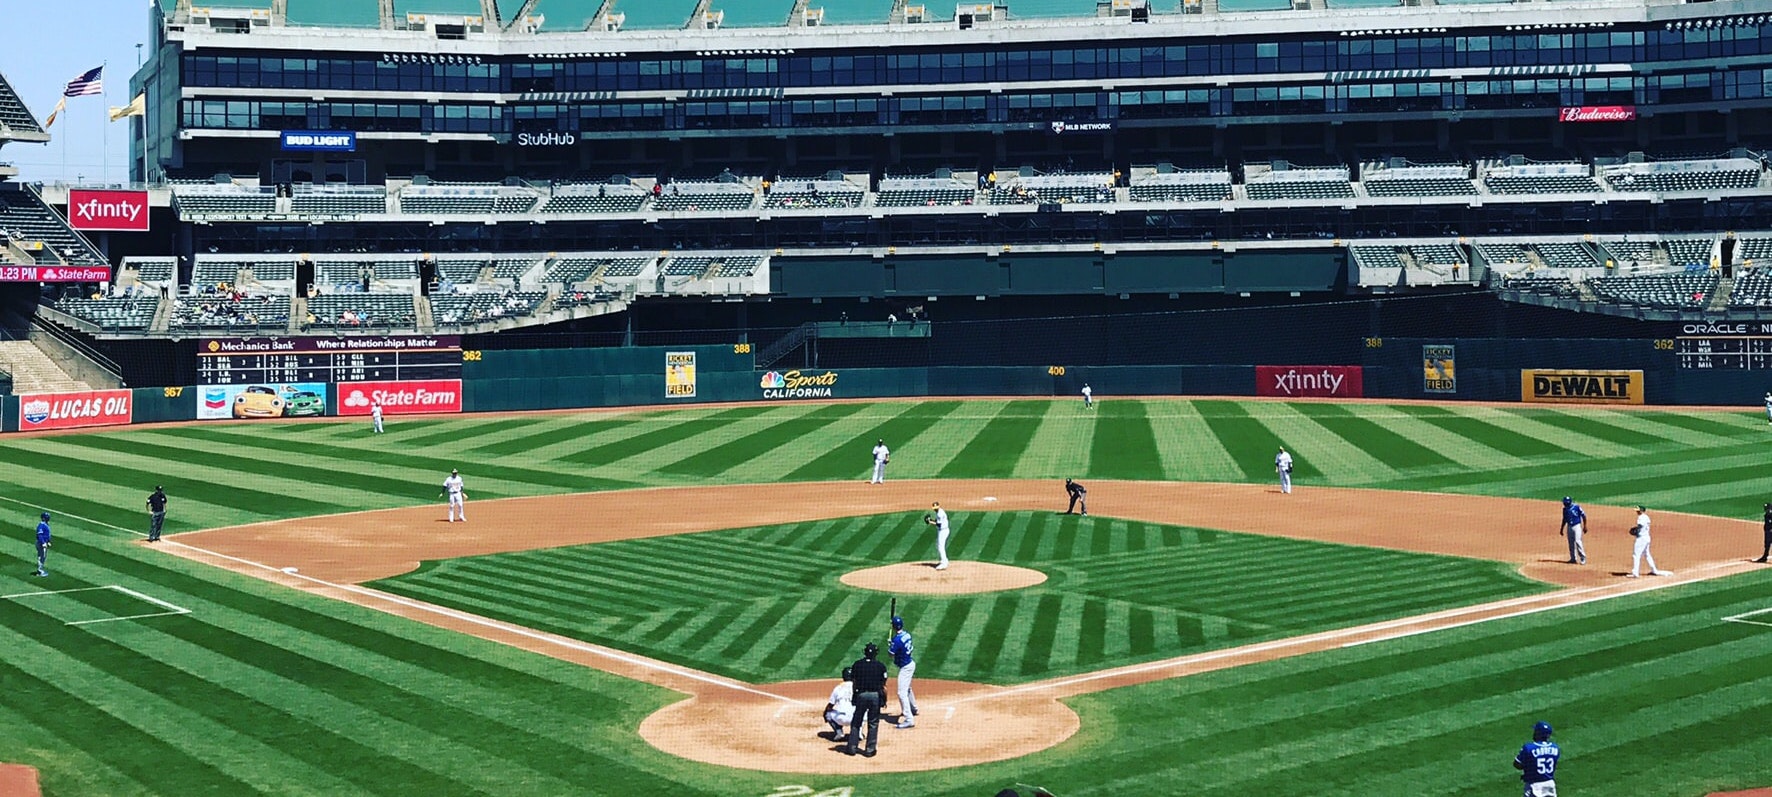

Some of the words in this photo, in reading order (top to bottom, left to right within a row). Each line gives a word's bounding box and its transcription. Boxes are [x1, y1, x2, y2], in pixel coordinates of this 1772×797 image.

[1562, 107, 1632, 121] Budweiser
[286, 135, 313, 145] BUD
[313, 136, 350, 146] LIGHT
[518, 132, 575, 146] StubHub
[77, 198, 142, 222] xfinity
[22, 267, 37, 280] PM
[1683, 324, 1747, 334] ORACLE
[221, 341, 270, 351] Mechanics
[272, 340, 294, 350] Bank
[316, 340, 345, 349] Where
[347, 339, 405, 349] Relationships
[407, 338, 437, 347] Matter
[1366, 338, 1382, 348] 388
[1653, 340, 1674, 350] 362
[734, 344, 750, 354] 388
[462, 350, 482, 361] 362
[1047, 365, 1065, 376] 400
[783, 370, 838, 388] Sports
[1274, 369, 1344, 394] xfinity
[1426, 380, 1453, 389] FIELD
[164, 387, 183, 398] 367
[668, 385, 693, 394] FIELD
[763, 388, 832, 398] CALIFORNIA
[50, 398, 102, 419] LUCAS
[104, 396, 128, 416] OIL
[1536, 757, 1554, 774] 53
